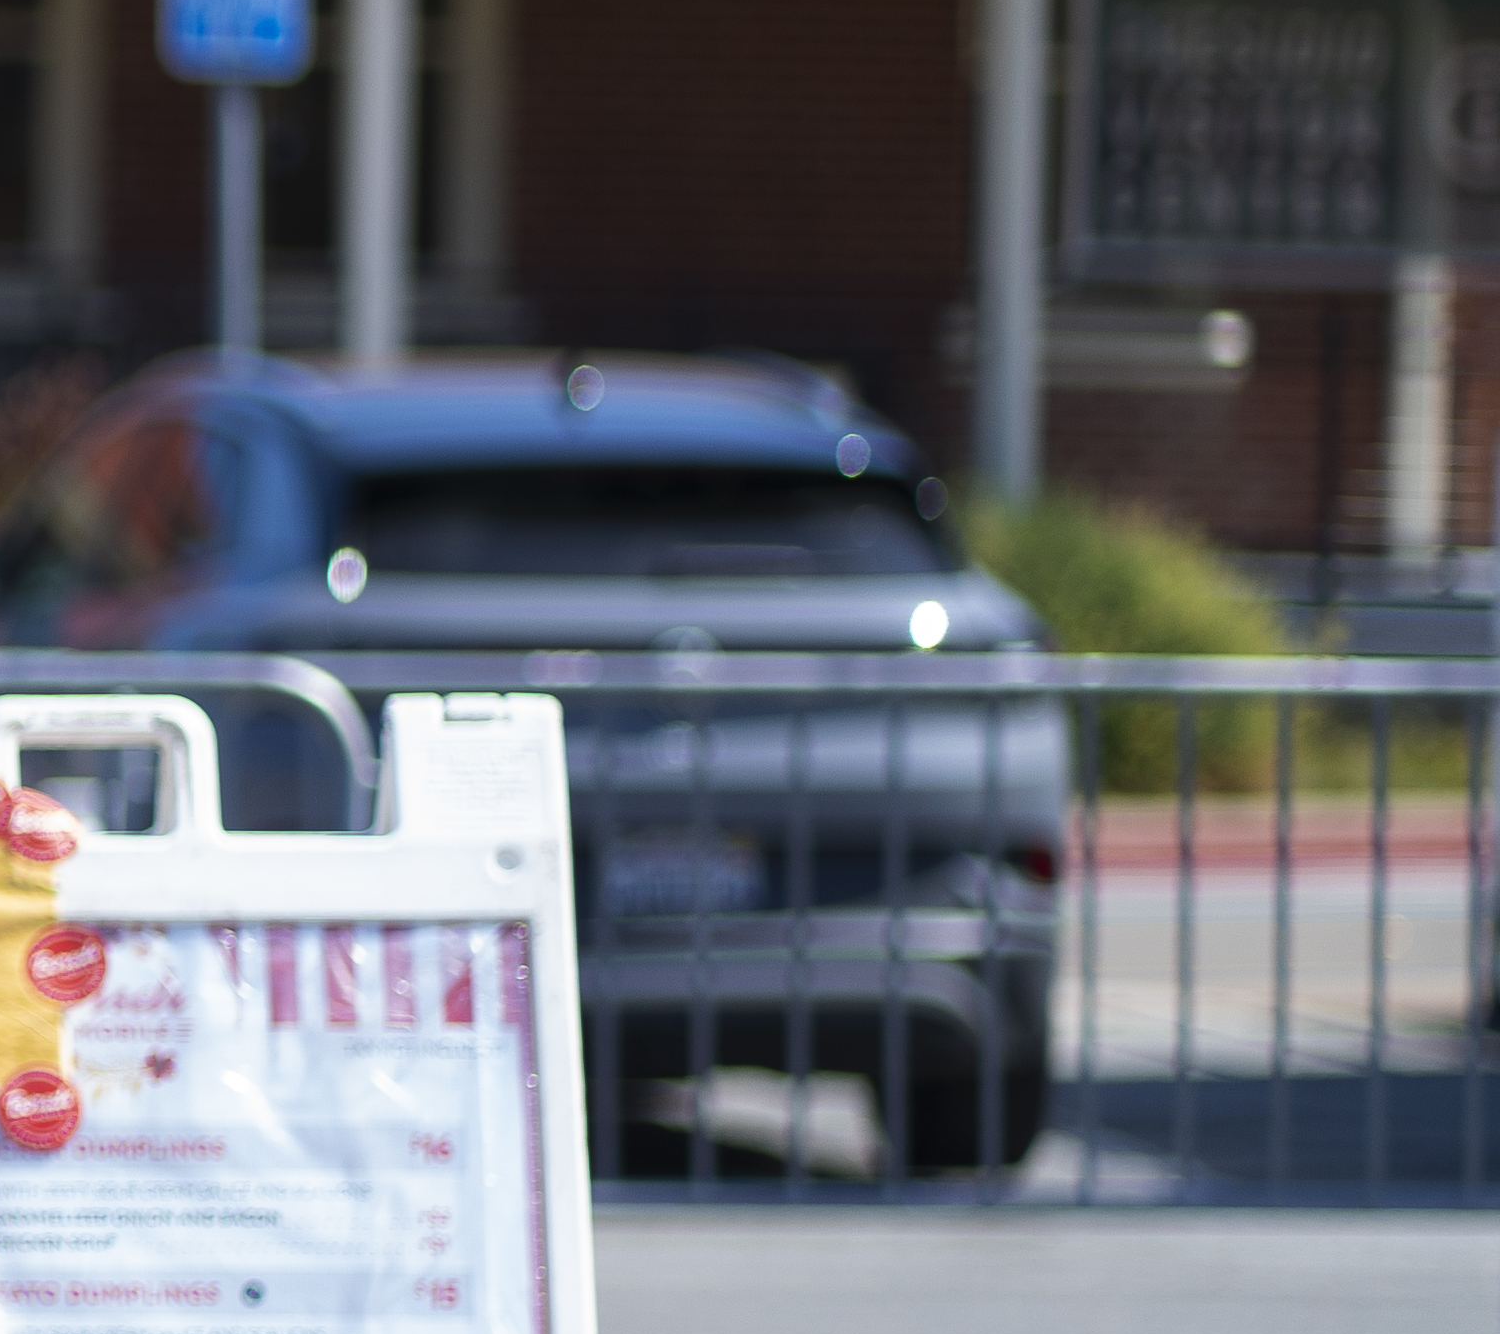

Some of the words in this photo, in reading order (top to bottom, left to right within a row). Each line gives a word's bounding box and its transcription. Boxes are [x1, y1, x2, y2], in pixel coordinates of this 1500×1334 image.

[71, 1135, 228, 1162] DUMPLINGS
[408, 1131, 457, 1165] $16
[219, 1207, 283, 1229] BACON
[65, 1279, 222, 1307] DUMPLINGS
[412, 1278, 461, 1311] $15
